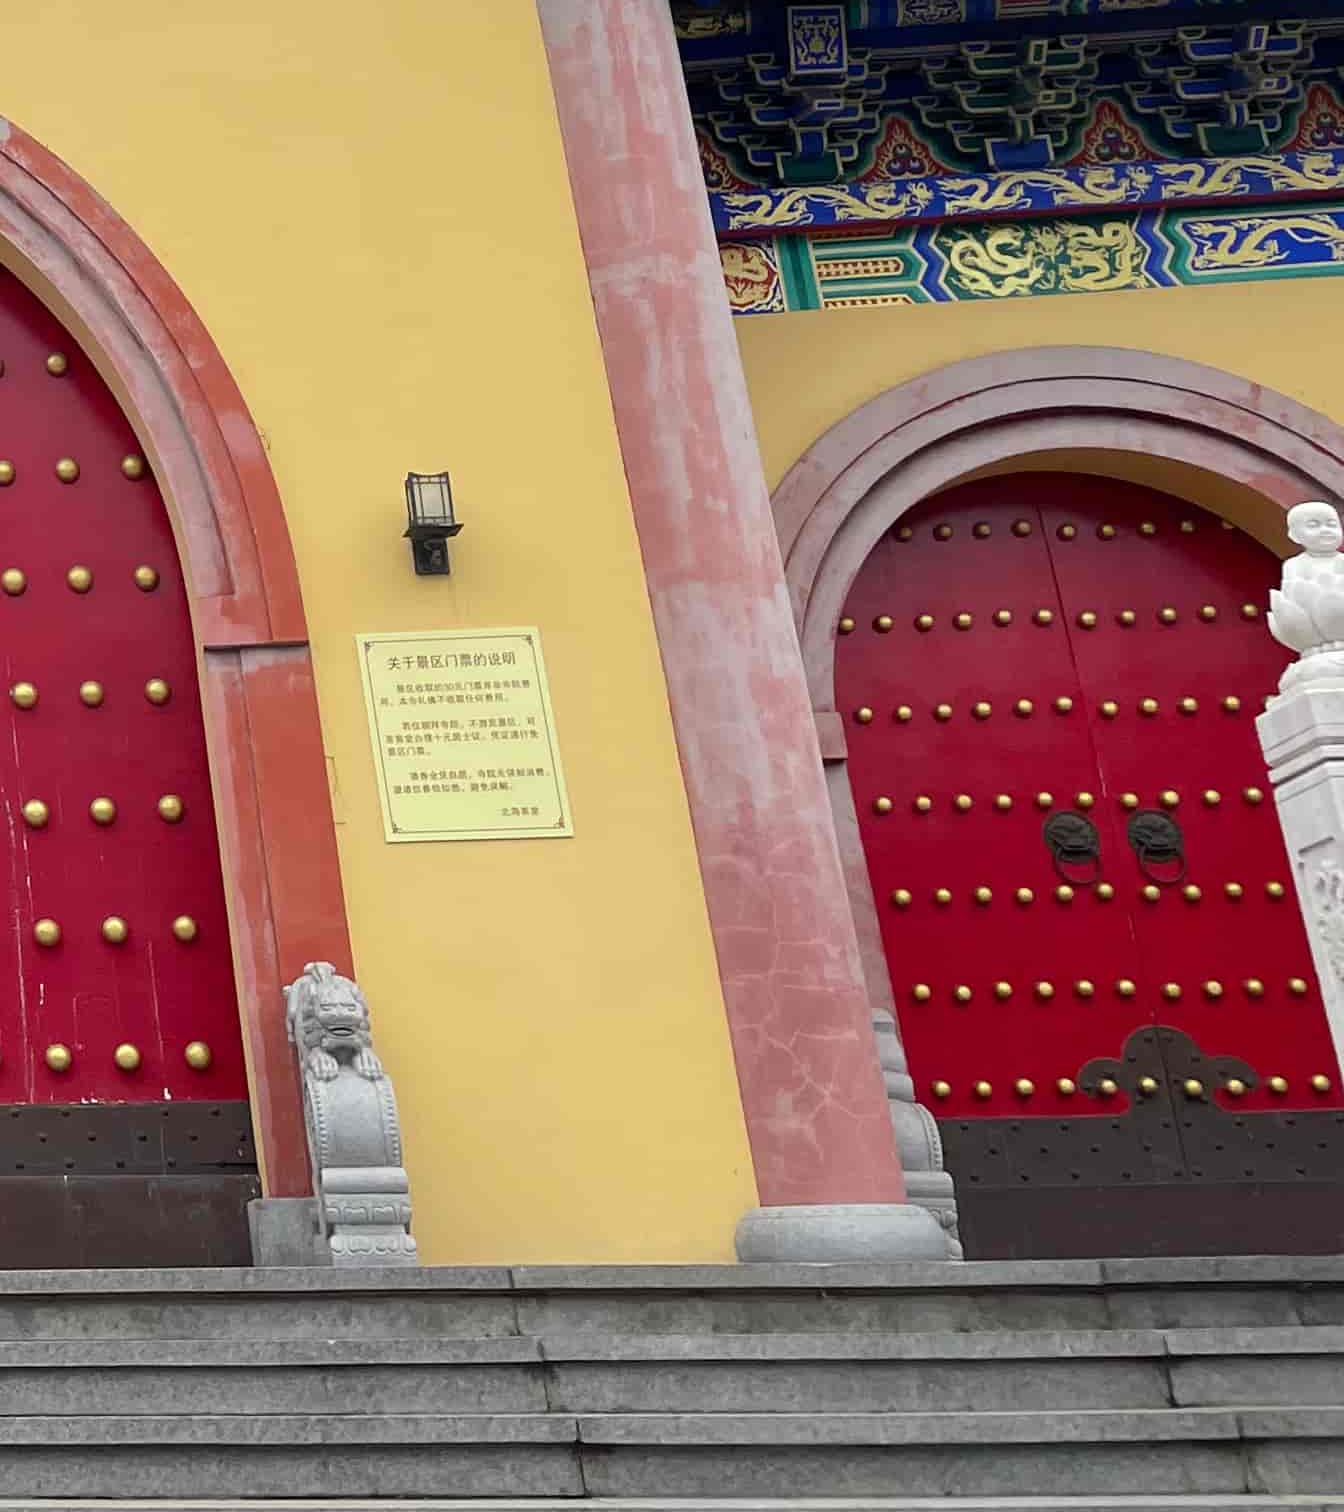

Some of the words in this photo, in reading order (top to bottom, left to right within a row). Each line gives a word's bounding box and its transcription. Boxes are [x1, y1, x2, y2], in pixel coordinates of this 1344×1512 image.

[388, 651, 516, 670] 关于景区门票的说明
